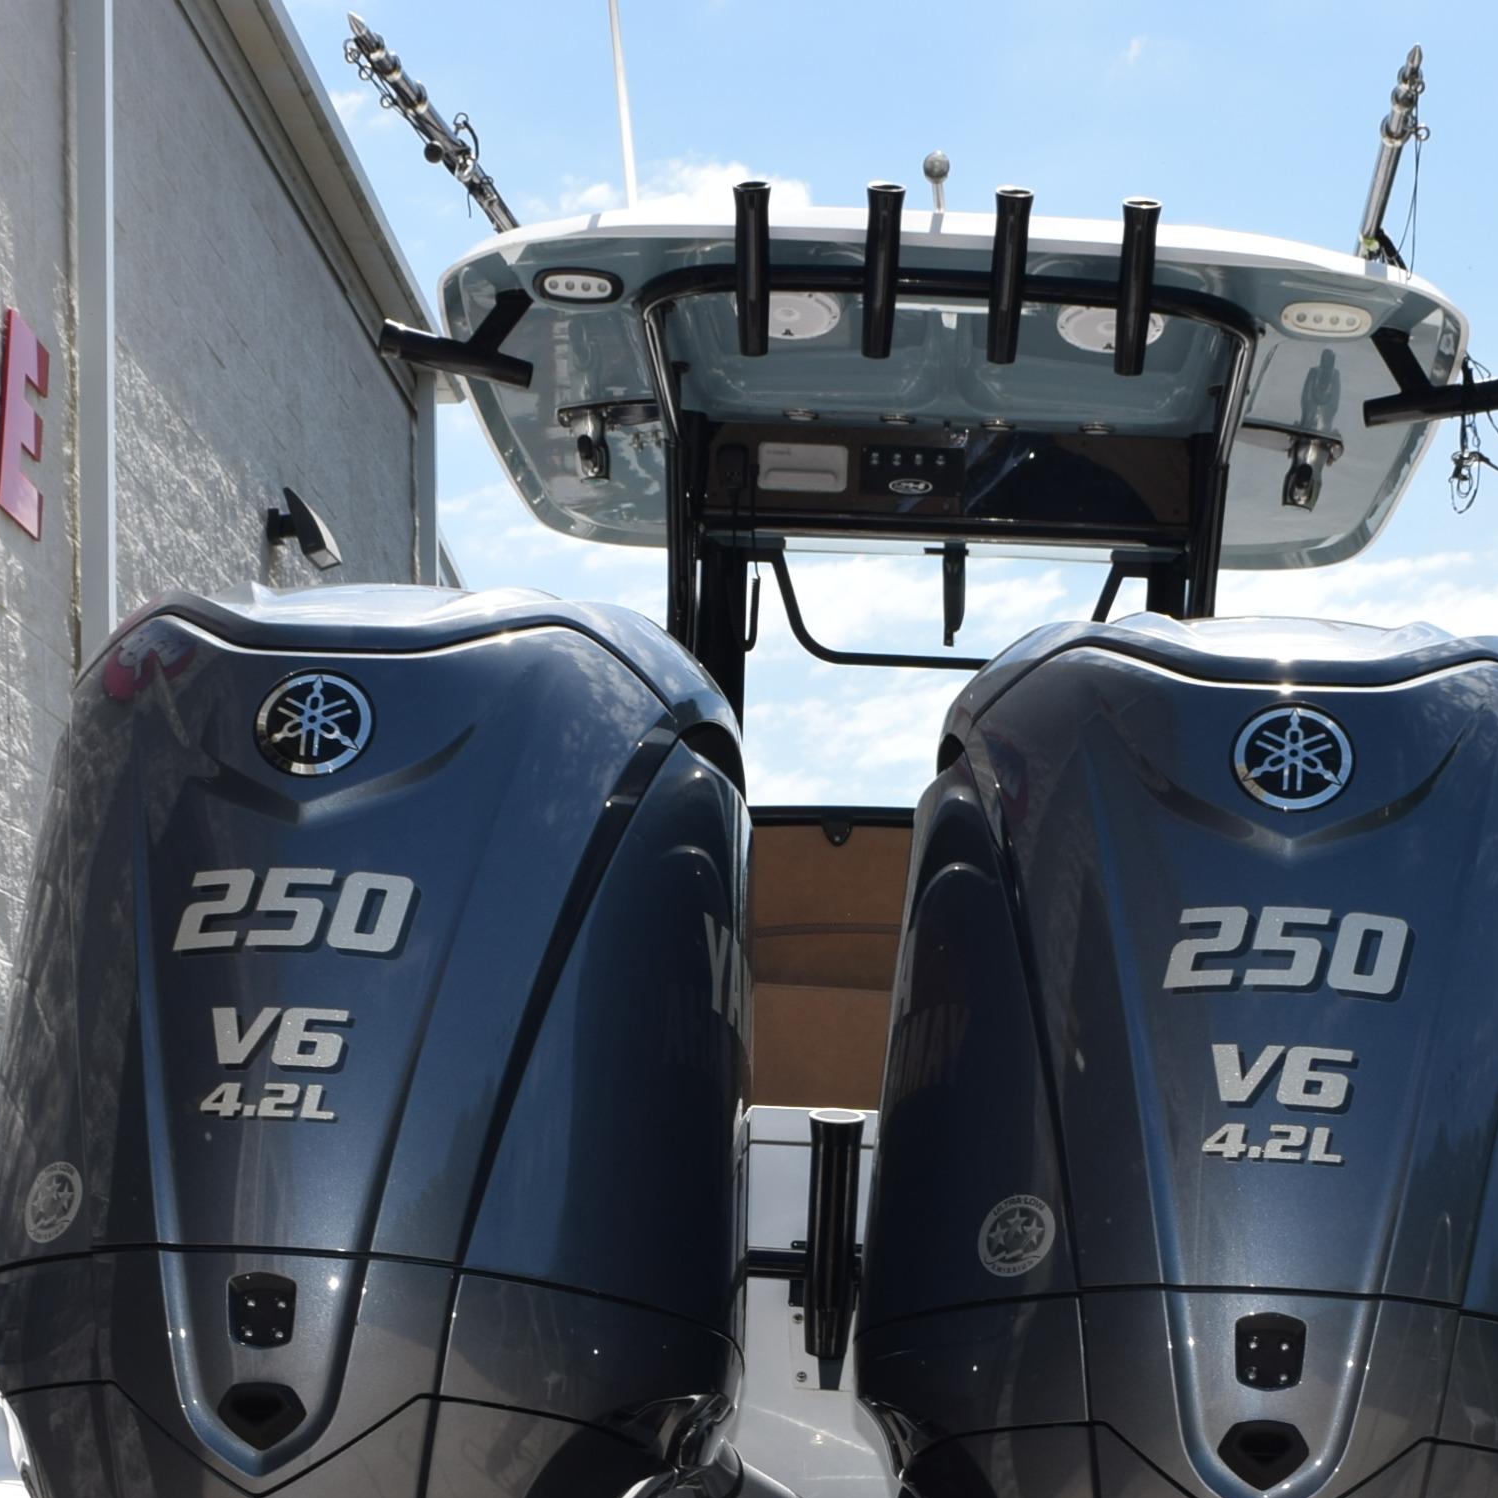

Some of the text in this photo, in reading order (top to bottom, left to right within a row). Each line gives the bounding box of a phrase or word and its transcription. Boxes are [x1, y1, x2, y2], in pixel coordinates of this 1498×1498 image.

[173, 867, 418, 957] 250
[1162, 906, 1412, 997] 250
[212, 1007, 351, 1071] V6
[200, 1082, 337, 1121] 4.2L
[1212, 1044, 1355, 1110] V6
[1201, 1123, 1344, 1164] 4.2L
